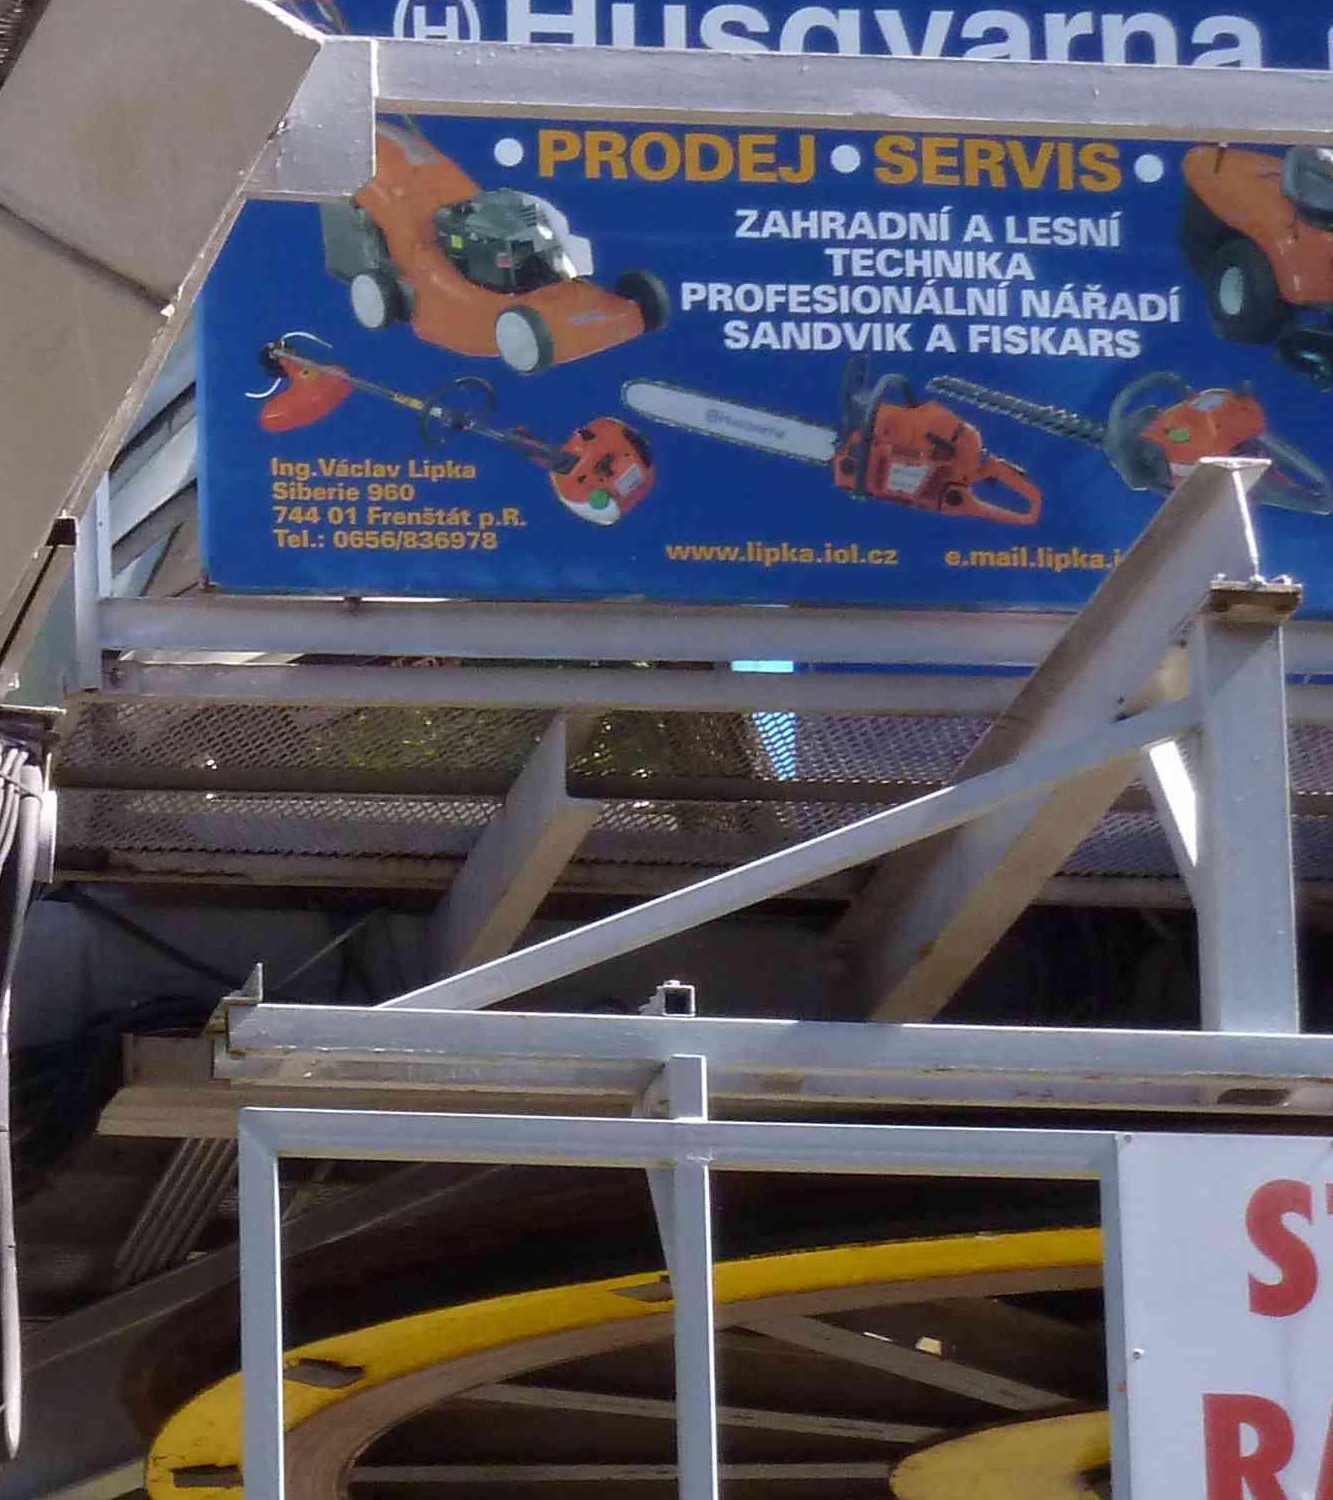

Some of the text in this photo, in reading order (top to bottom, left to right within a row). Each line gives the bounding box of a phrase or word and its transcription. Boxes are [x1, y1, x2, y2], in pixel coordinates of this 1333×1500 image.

[538, 129, 1123, 192] PRODEJ SERVIS
[735, 206, 1122, 247] ZAHRADNÍ A LESNÍ
[824, 248, 1035, 280] TECHNIKA
[681, 279, 1181, 323] PROFESIONÁLNÍ NÁŘADÍ
[724, 320, 1141, 359] SANDVIK A FISKARS
[408, 459, 476, 482] Lipka
[367, 483, 416, 502] 960
[273, 506, 320, 525] 744
[327, 506, 357, 525] 01
[273, 529, 325, 549] Tel.:
[1245, 1178, 1333, 1318] S
[1202, 1392, 1333, 1500] R
